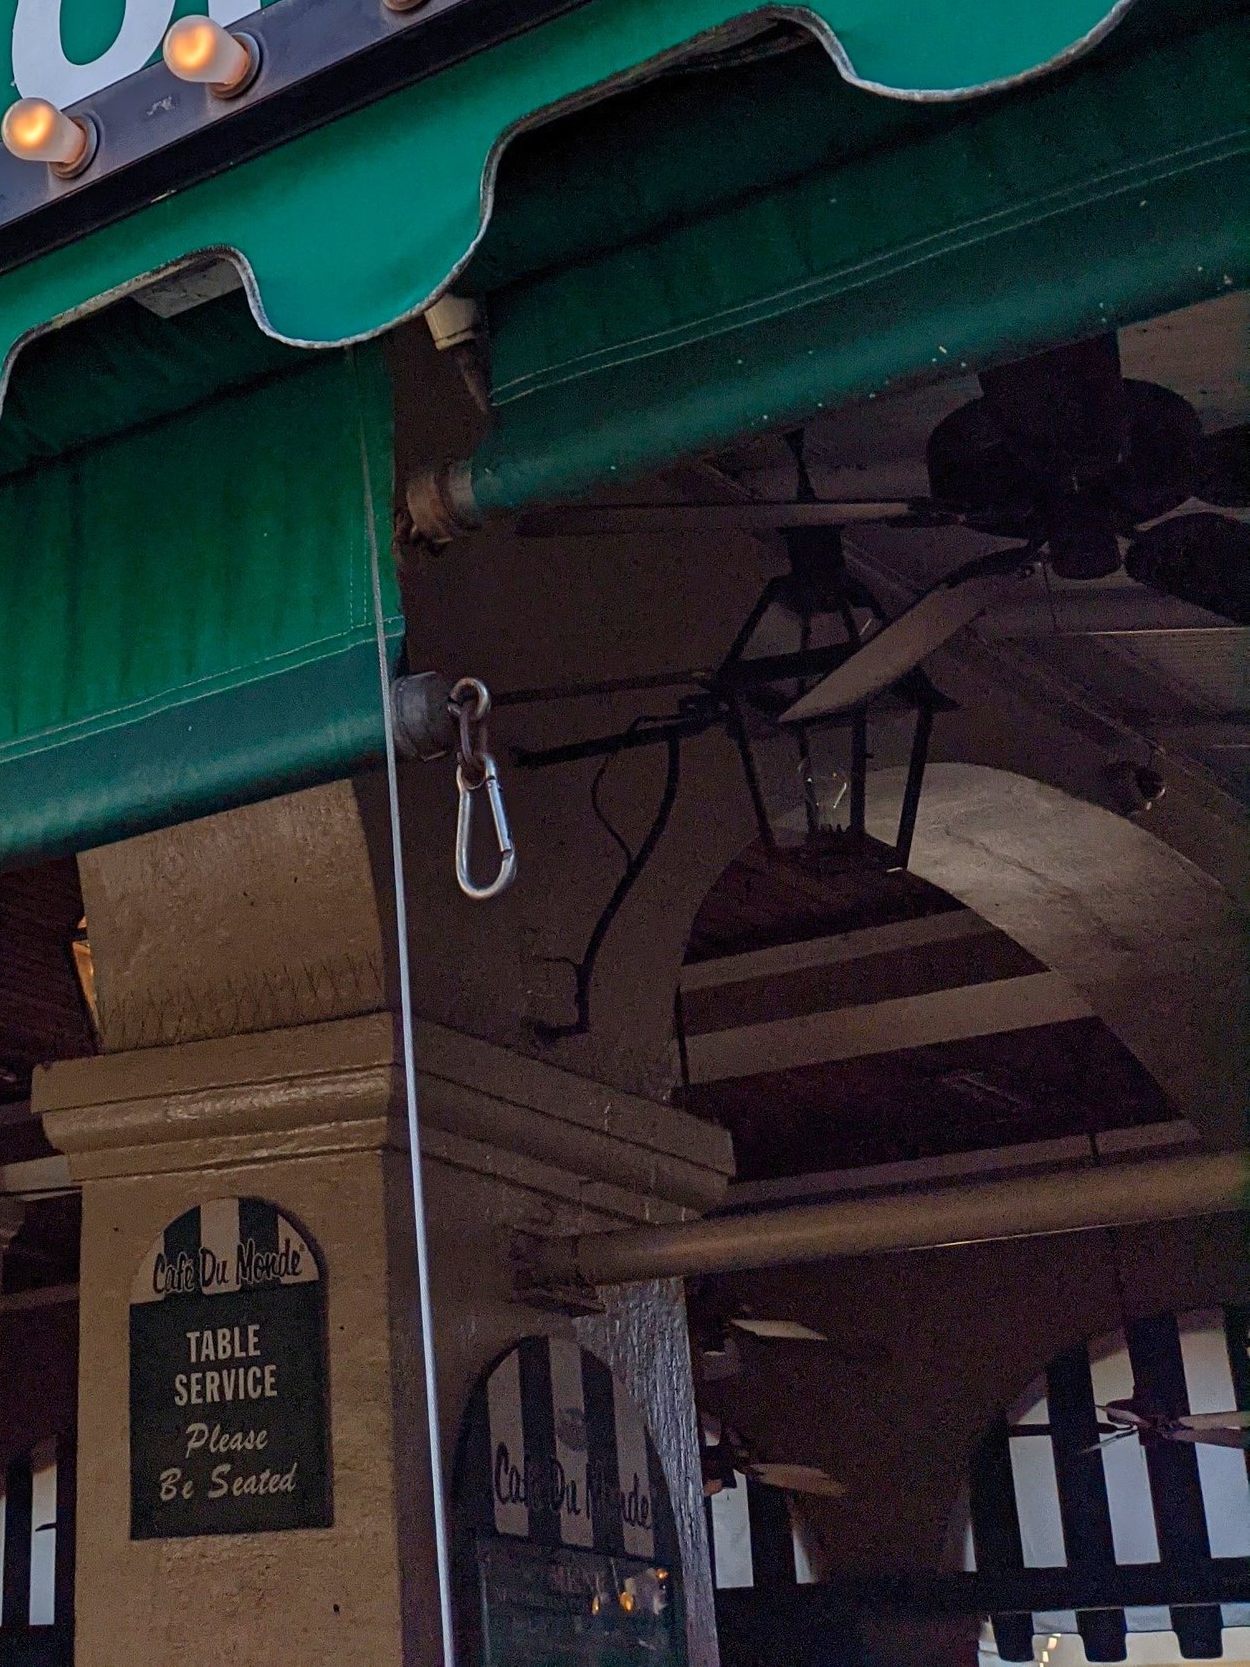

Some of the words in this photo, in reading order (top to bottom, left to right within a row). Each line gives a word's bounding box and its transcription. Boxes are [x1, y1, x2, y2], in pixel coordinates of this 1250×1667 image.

[199, 1246, 230, 1288] Du
[236, 1238, 302, 1285] Monde
[186, 1324, 261, 1363] TABLE
[175, 1364, 277, 1407] SERVICE
[185, 1422, 268, 1459] Please
[159, 1467, 193, 1502] Be
[207, 1462, 299, 1500] Seated
[496, 1441, 546, 1511] Ca
[549, 1454, 581, 1516] Du
[586, 1461, 652, 1531] Mde
